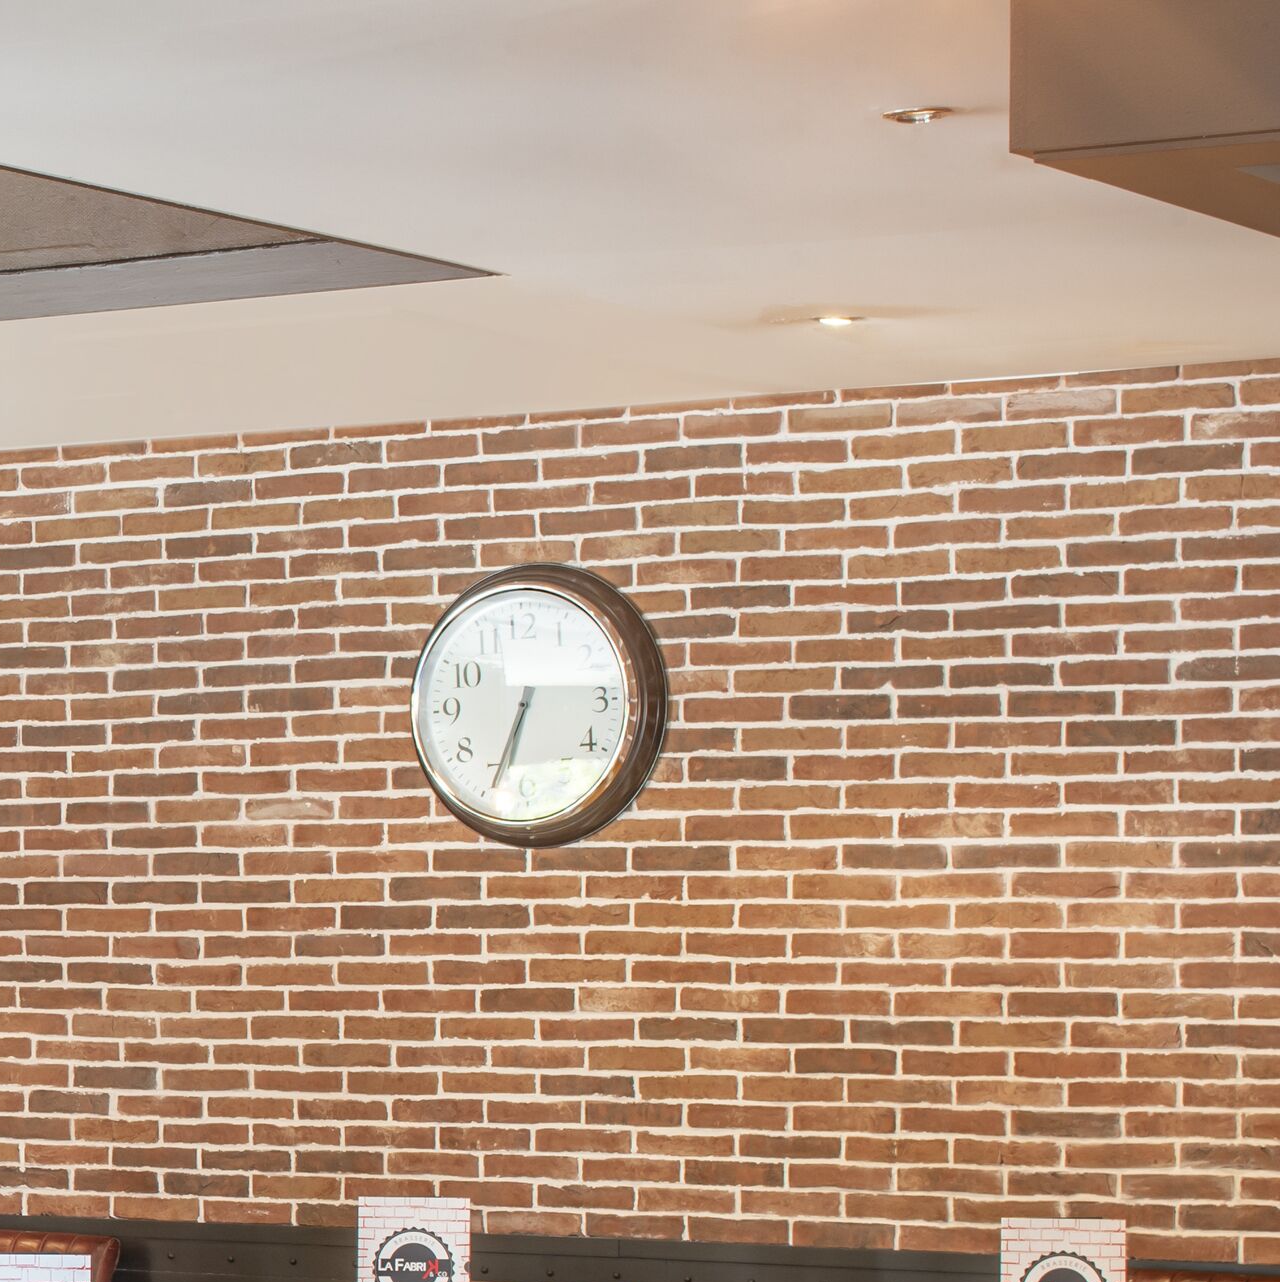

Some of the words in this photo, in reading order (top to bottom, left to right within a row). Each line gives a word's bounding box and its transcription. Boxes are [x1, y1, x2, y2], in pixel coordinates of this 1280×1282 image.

[508, 612, 537, 640] 12
[453, 661, 482, 688] 10
[442, 698, 461, 725] 9
[591, 686, 609, 713] 3
[456, 736, 473, 763] 8
[579, 725, 597, 752] 4
[377, 1258, 393, 1272] LA
